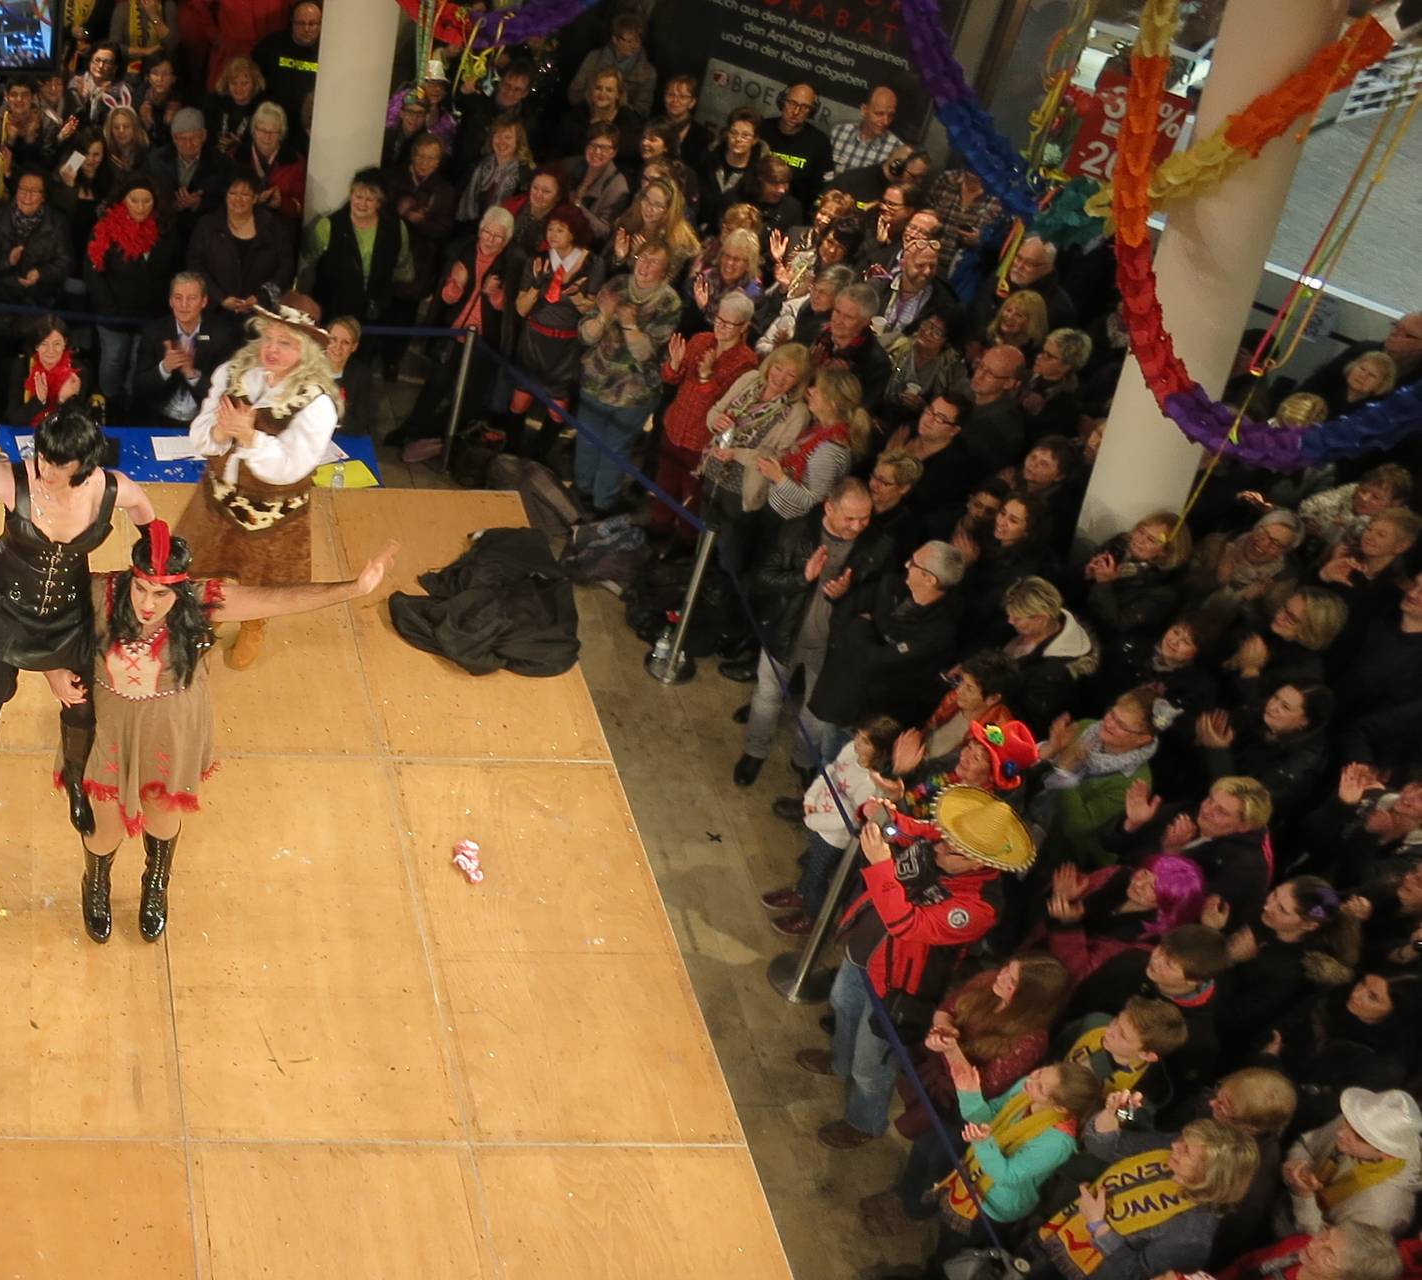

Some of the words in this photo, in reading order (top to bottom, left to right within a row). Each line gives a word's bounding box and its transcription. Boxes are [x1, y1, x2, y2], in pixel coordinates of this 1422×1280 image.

[721, 31, 743, 46] und
[767, 28, 804, 53] Antrag
[789, 19, 826, 43] Antrag
